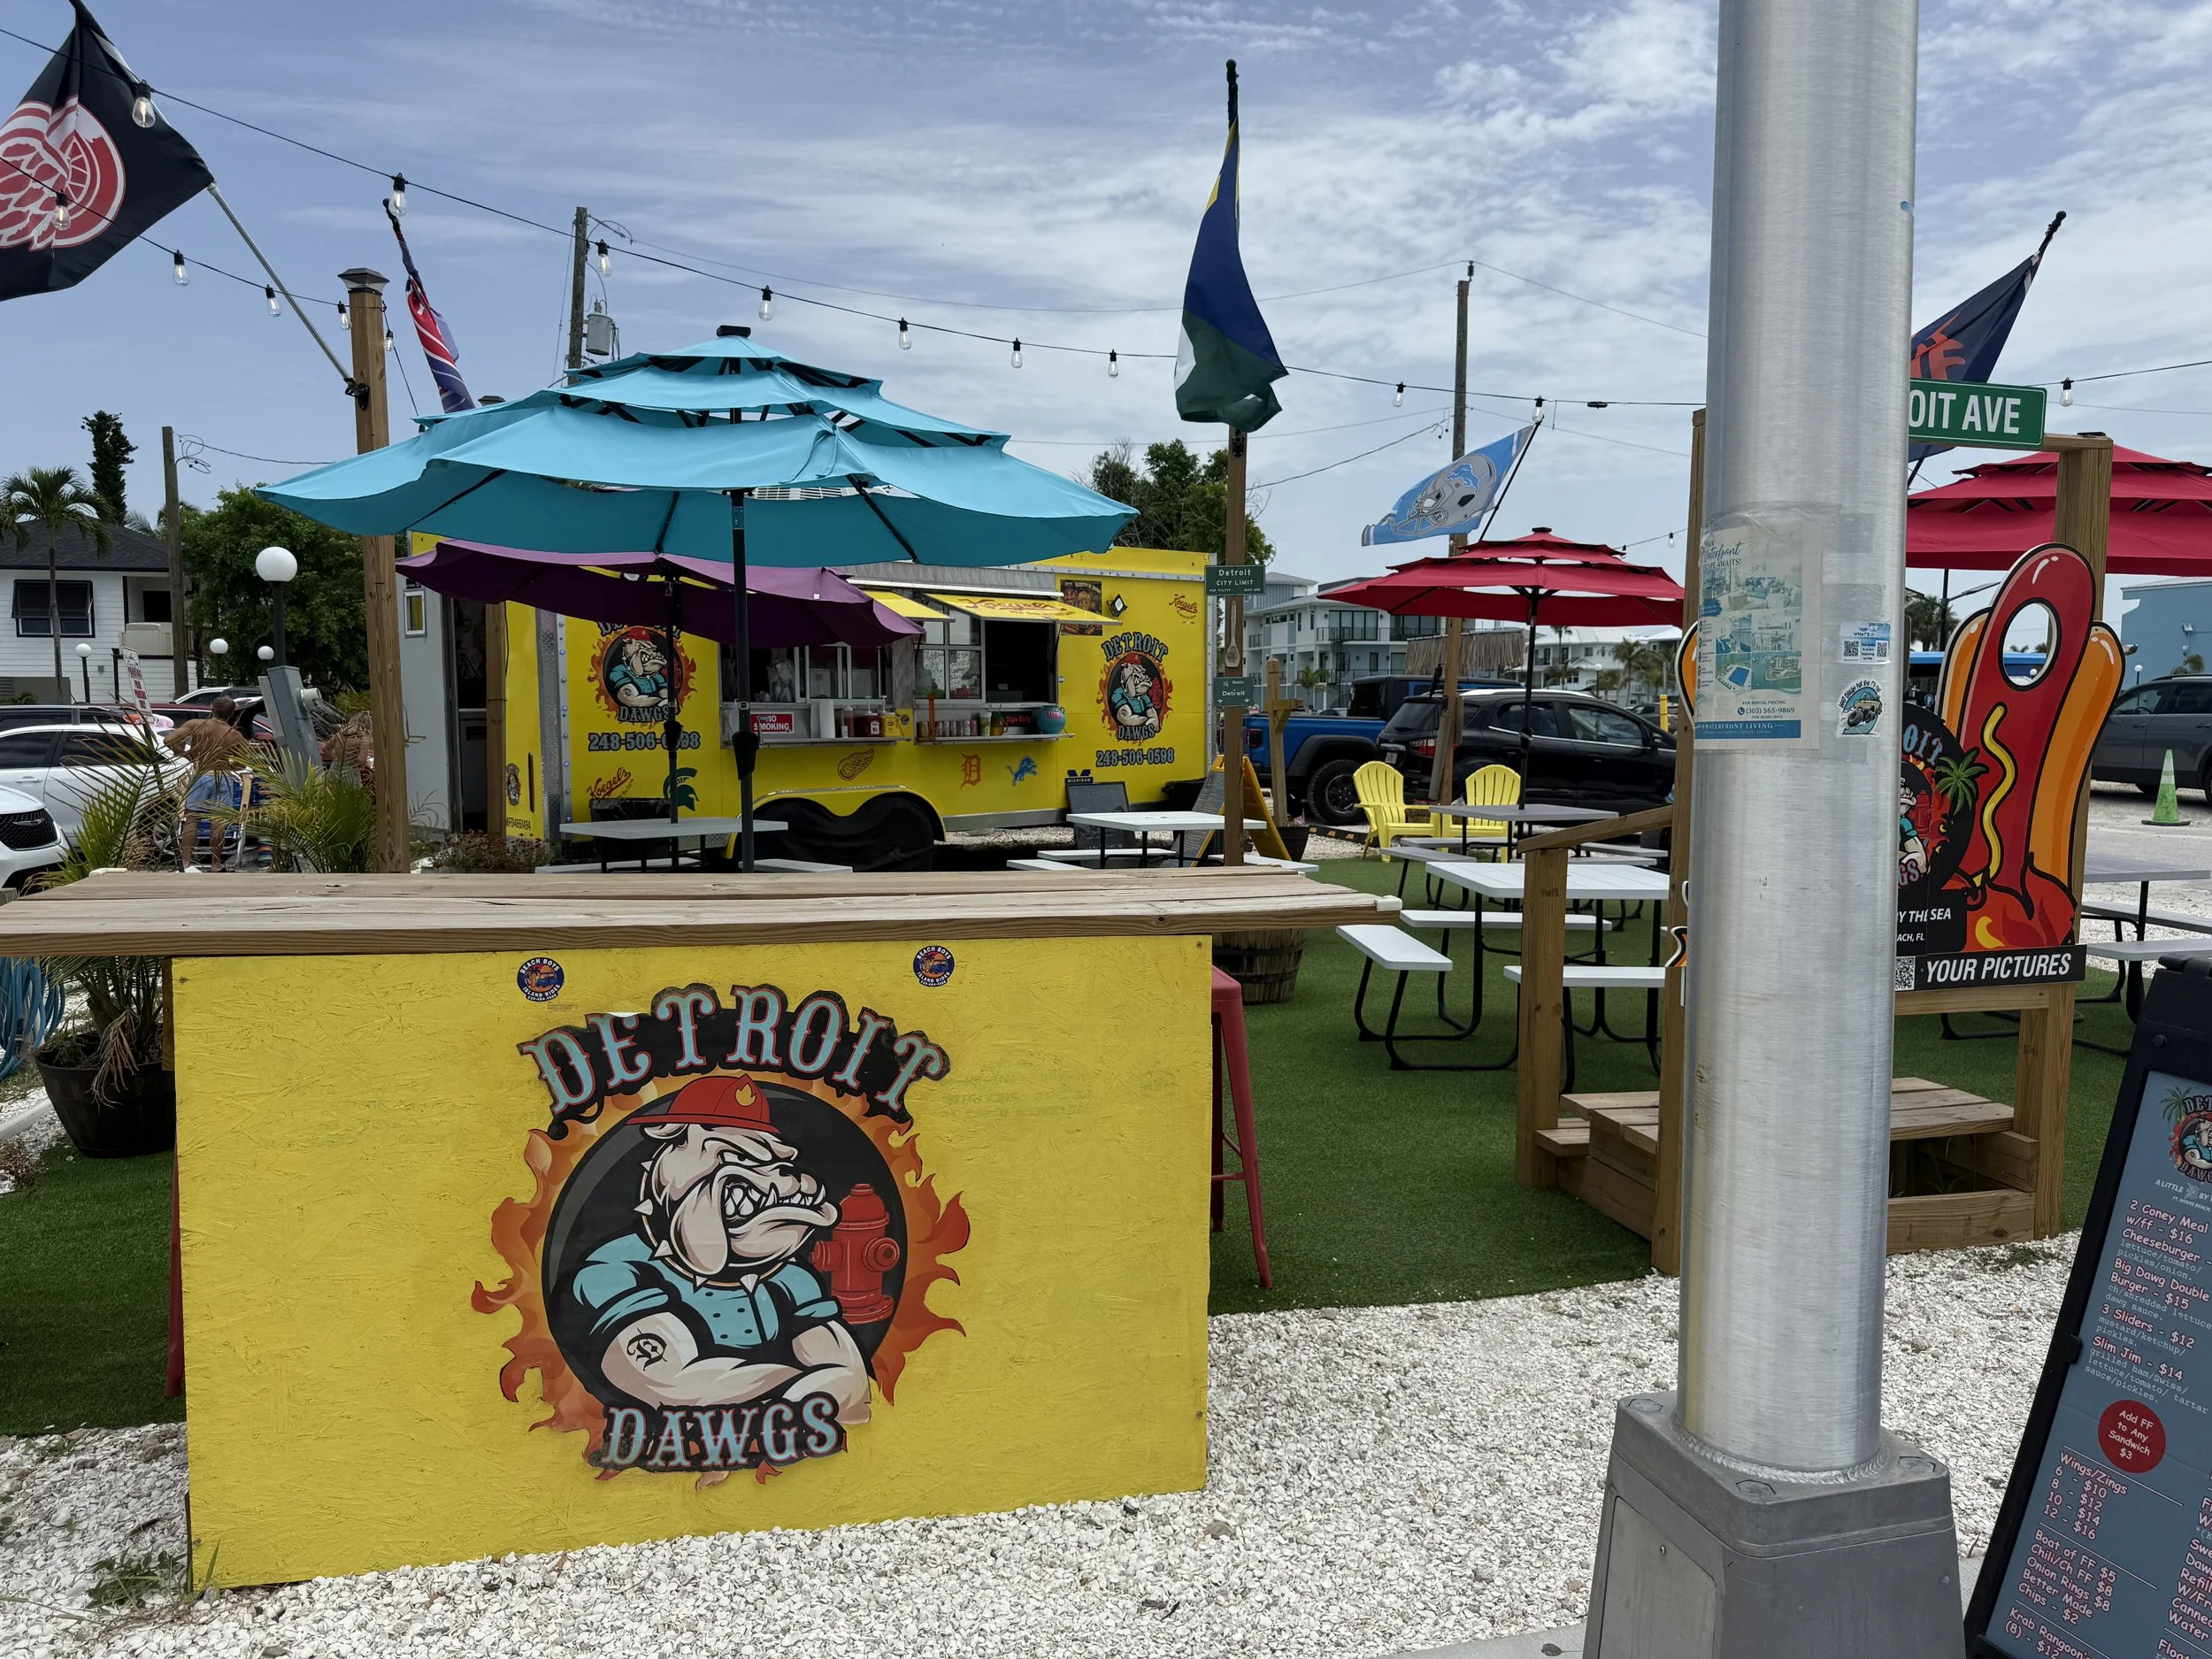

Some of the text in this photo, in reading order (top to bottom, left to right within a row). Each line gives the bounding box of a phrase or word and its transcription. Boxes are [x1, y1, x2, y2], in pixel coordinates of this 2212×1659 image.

[1961, 395, 2021, 434] AVE
[1717, 558, 1741, 567] AWAITS!
[1169, 594, 1197, 613] Koegel's
[1102, 633, 1168, 662] DETROIT
[619, 705, 669, 722] DAWGS
[1118, 725, 1156, 740] DAWGS
[1096, 747, 1175, 767] 248-506-0598
[587, 767, 631, 799] Koegel's
[1896, 910, 1907, 923] Y
[1930, 908, 1951, 920] SEA
[917, 947, 951, 959] BEACH BOYS
[1916, 933, 1924, 941] FL
[520, 959, 560, 974] BEACH BOYS
[918, 972, 950, 982] ISLAND RIDES
[1927, 952, 2072, 983] YOUR PICTURES
[522, 984, 560, 997] ISLAND RIDES
[520, 987, 945, 1116] DETROIT
[2161, 1180, 2185, 1193] LITTLE
[2179, 1198, 2195, 1207] MYERS
[2126, 1216, 2193, 1244] w/ff $16
[2130, 1199, 2209, 1233] 2 Coney Meal
[2120, 1240, 2202, 1274] lettuce/tomato/
[2123, 1228, 2200, 1262] Cheeseburger
[2115, 1257, 2209, 1302] Big Dawg Double
[2117, 1249, 2192, 1280] pickles/onion.
[2106, 1293, 2162, 1321] dawg sauce.
[2108, 1285, 2212, 1329] ch/shredded lettuce
[2110, 1271, 2190, 1310] Burger $15
[2095, 1325, 2137, 1347] pickles.
[2098, 1316, 2186, 1356] mustard/ketchup/
[2102, 1303, 2194, 1349] 3 Sliders $12
[2090, 1348, 2188, 1394] grilled ham/Swiss/
[2093, 1336, 2184, 1380] Slim Jim $14
[2085, 1365, 2158, 1402] sauce/pickles.
[2088, 1356, 2208, 1414] lettuce/tomato/ tartar
[603, 1396, 839, 1468] DAWGS
[2117, 1421, 2148, 1443] to Any
[2119, 1410, 2154, 1430] Add FF
[2108, 1431, 2150, 1456] Sandwich
[2119, 1448, 2132, 1460] $3
[2055, 1466, 2107, 1499] 6 $10
[2060, 1452, 2128, 1494] Wings/Zings
[2047, 1492, 2101, 1526] 10 $14
[2051, 1479, 2103, 1512] 8 $12
[2044, 1504, 2096, 1540] 12 $16
[2031, 1543, 2113, 1597] Chili/Ch FF $8
[2035, 1529, 2117, 1583] Boat of FF $5
[2023, 1568, 2093, 1618] Better Made
[2027, 1556, 2111, 1612] Onion Rings $8
[2177, 1581, 2212, 1610] W/Fr
[2018, 1582, 2079, 1625] Chips $2
[2005, 1620, 2060, 1659] (8) $12
[2009, 1607, 2092, 1659] Krab Rangoon'
[2169, 1609, 2209, 1640] Water
